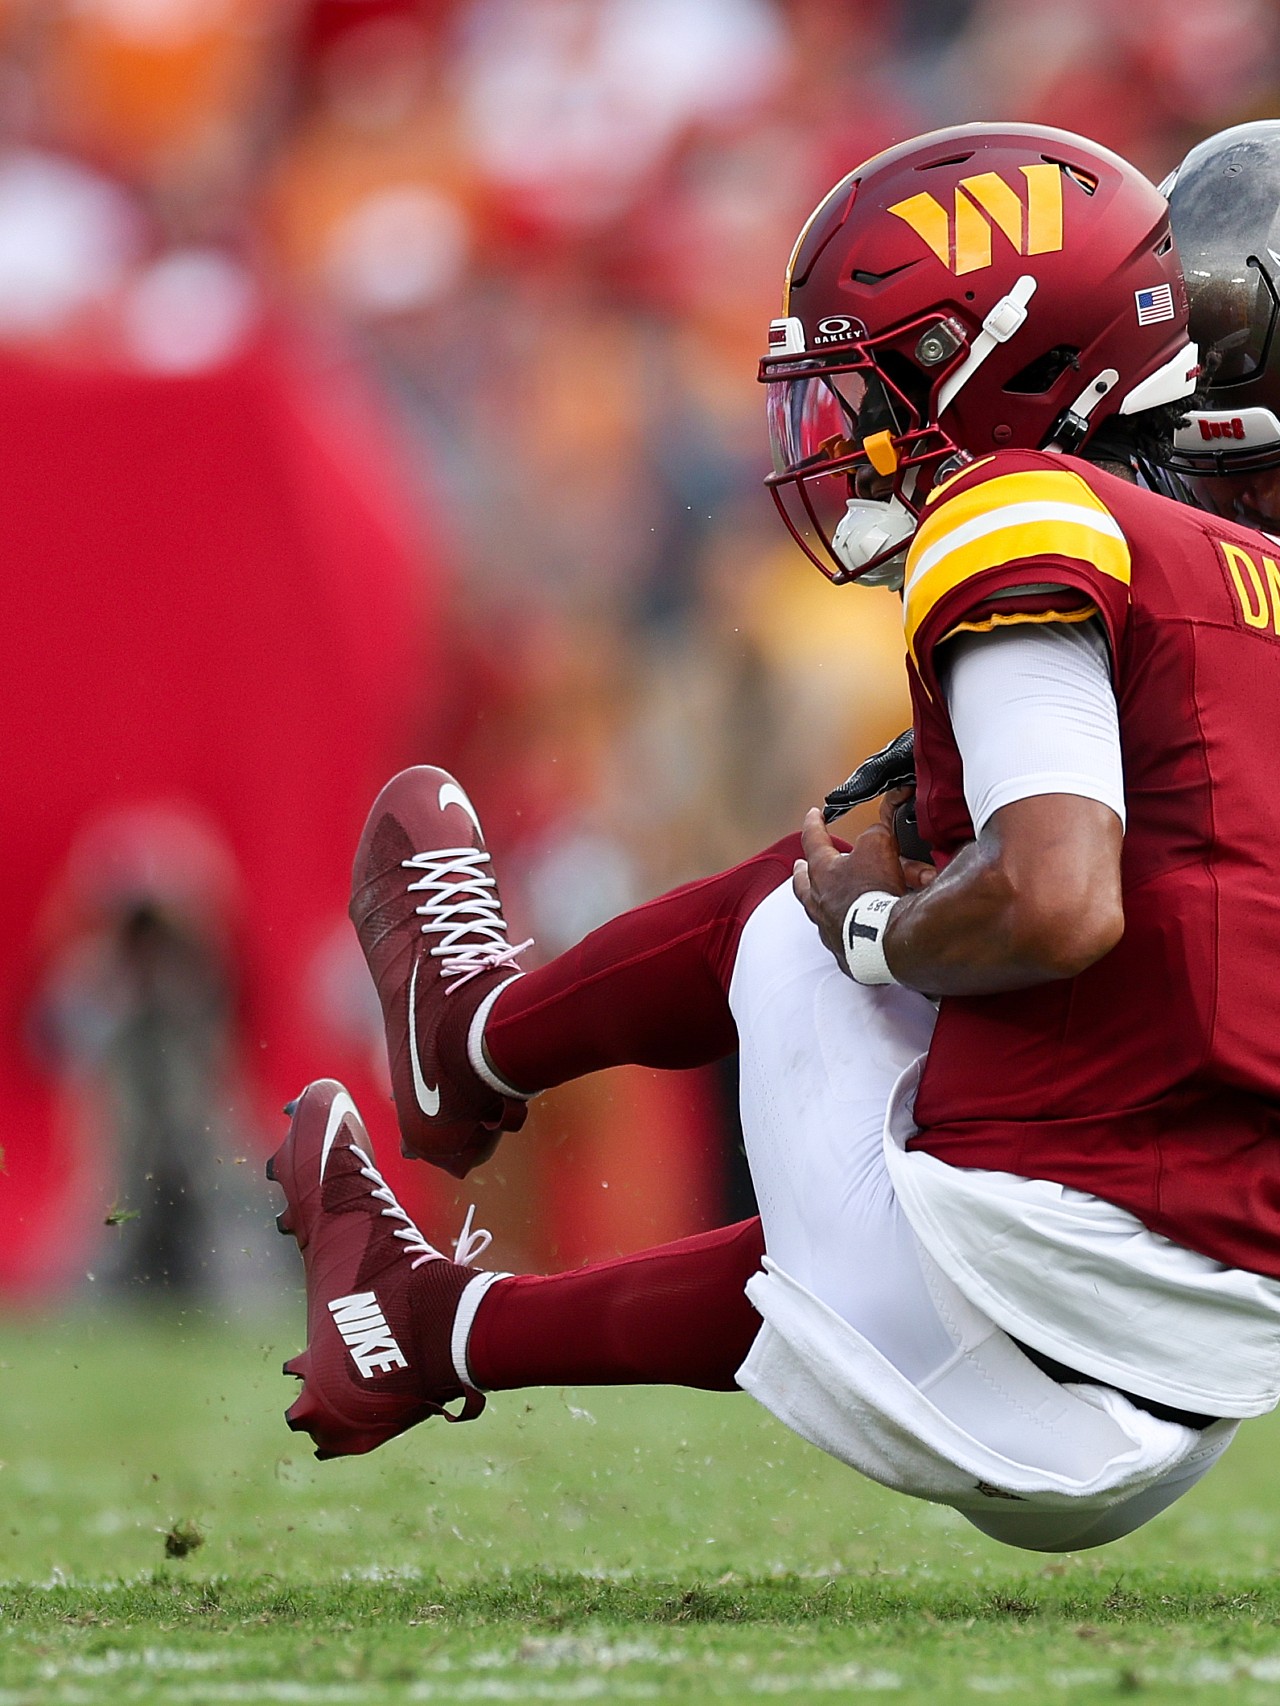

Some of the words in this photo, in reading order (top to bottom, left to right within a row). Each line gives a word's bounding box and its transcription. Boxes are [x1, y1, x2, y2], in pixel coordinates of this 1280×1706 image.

[886, 163, 1063, 276] W
[814, 330, 863, 345] OAKLEY
[848, 908, 879, 950] T
[327, 1291, 409, 1379] NIKE
